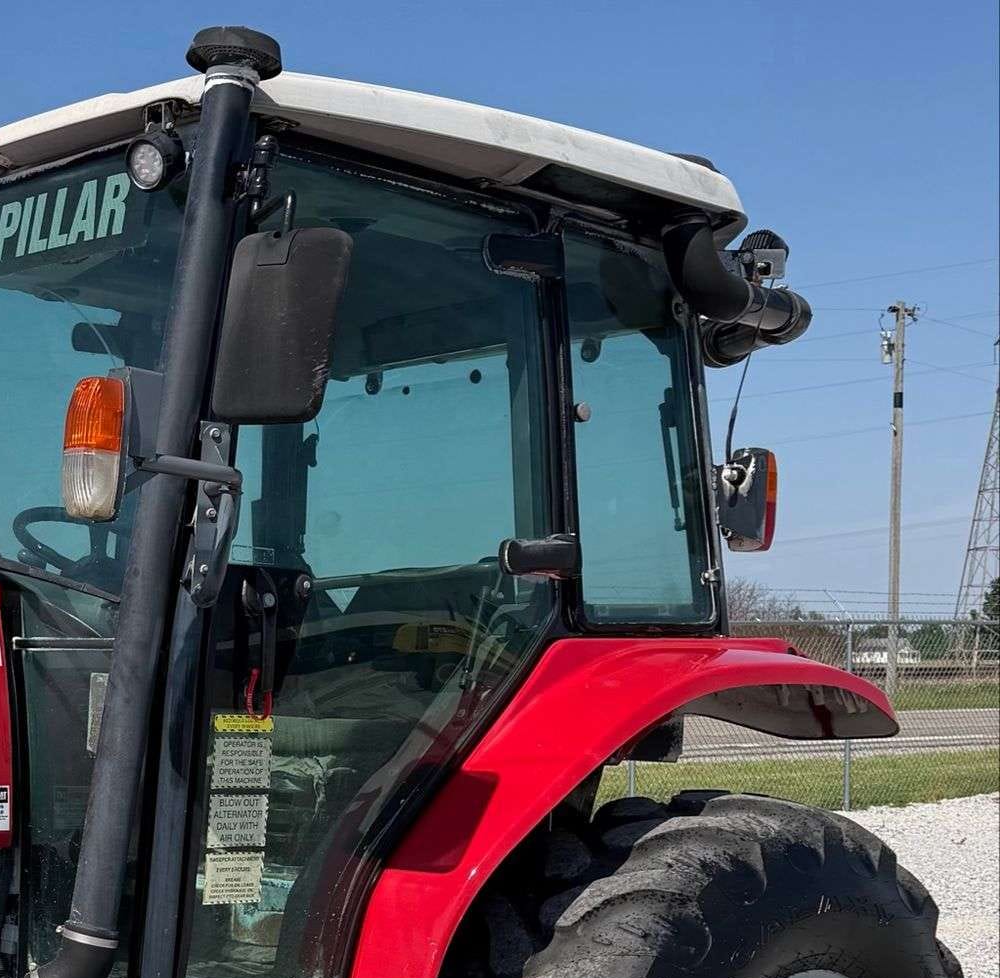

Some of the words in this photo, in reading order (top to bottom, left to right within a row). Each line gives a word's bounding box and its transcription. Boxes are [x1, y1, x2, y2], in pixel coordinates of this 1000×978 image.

[220, 799, 241, 807] BLOW
[243, 798, 259, 807] OUT
[214, 809, 263, 818] ALTERNATOR
[217, 822, 238, 830] DAILY
[239, 821, 258, 830] WITH
[220, 833, 233, 841] AIR
[234, 833, 254, 841] ONLY
